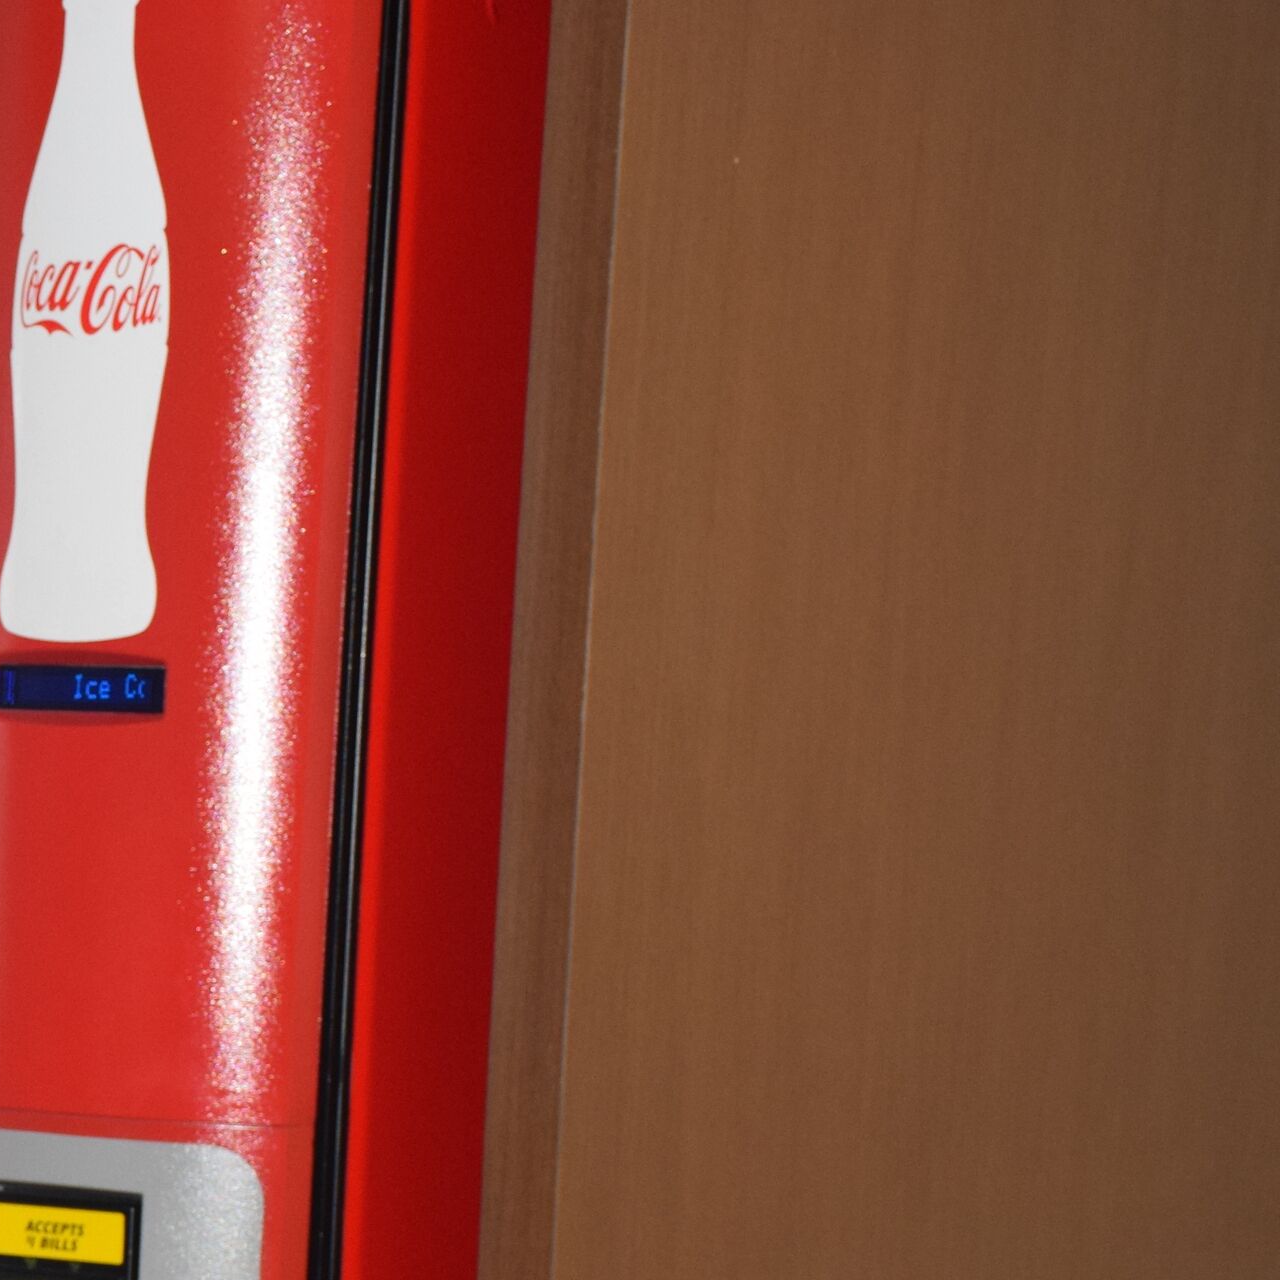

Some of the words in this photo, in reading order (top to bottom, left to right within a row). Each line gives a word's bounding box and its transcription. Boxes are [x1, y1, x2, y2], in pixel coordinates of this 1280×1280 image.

[20, 243, 162, 337] Coca-Cola
[73, 673, 111, 700] Ice
[23, 1219, 86, 1237] ACCEPTS
[39, 1237, 79, 1252] BILLS
